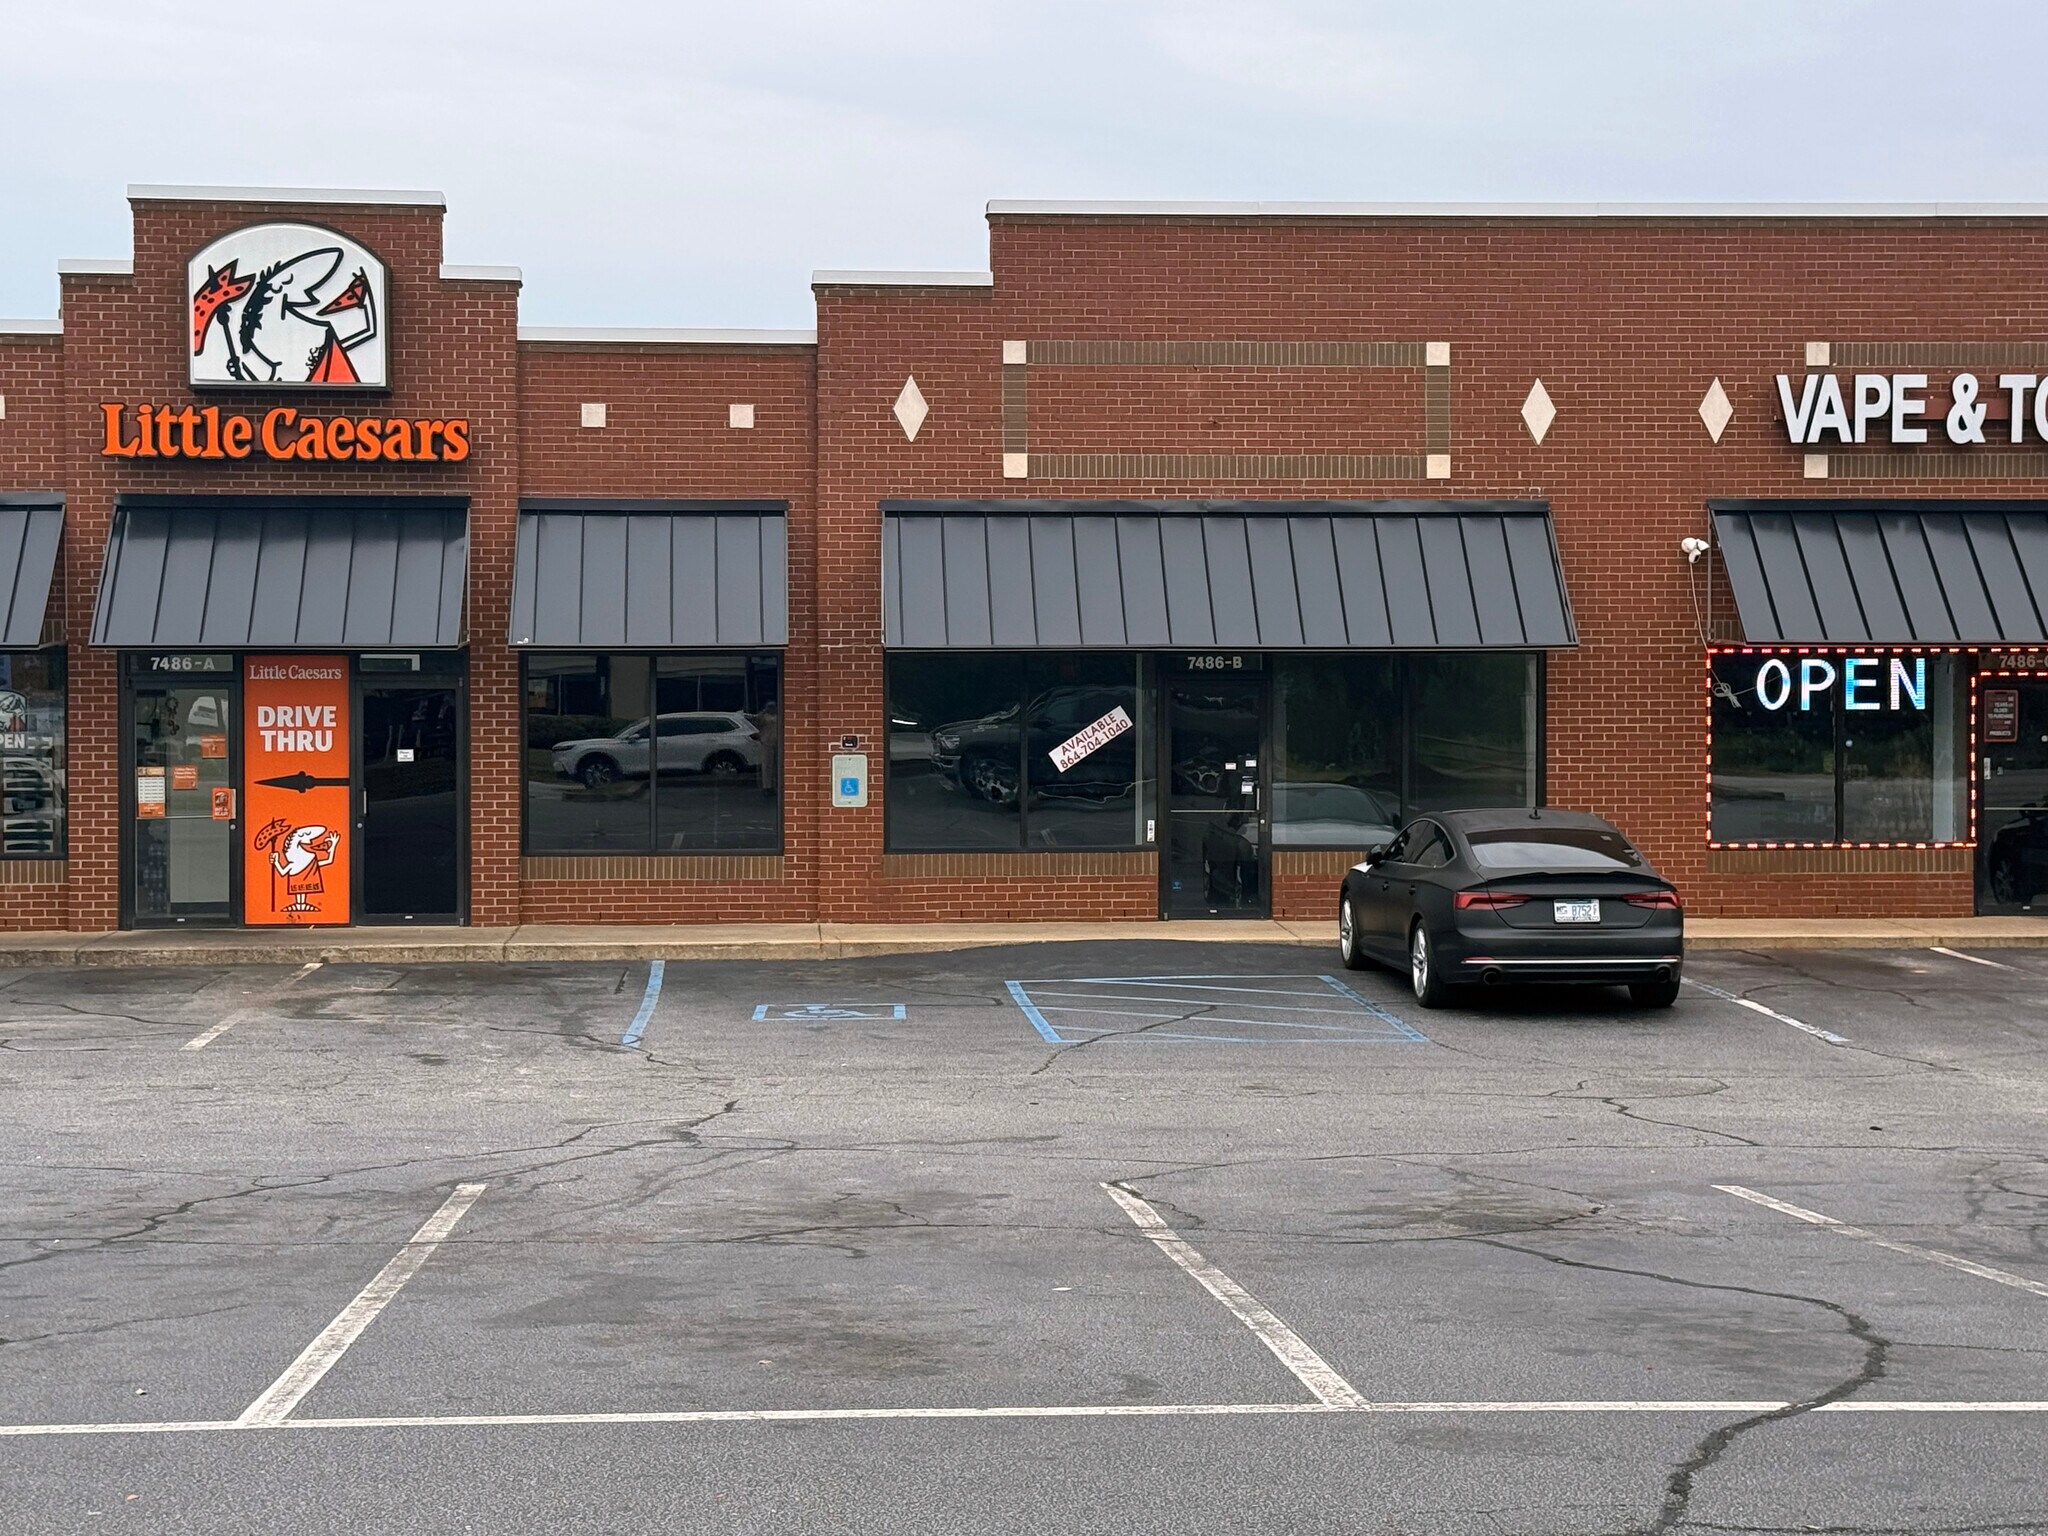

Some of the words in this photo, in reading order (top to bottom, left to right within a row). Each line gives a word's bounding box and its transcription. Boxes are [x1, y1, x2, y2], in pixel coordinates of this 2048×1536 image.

[1775, 374, 1928, 443] VAPE
[1946, 373, 1988, 444] &
[100, 402, 253, 460] Little
[261, 407, 471, 462] Caesars
[150, 656, 215, 670] 7486-A
[250, 665, 287, 680] Little
[288, 665, 342, 680] Caesars
[1187, 656, 1243, 670] 7486-B
[1999, 655, 2048, 669] 7486-
[1756, 657, 1926, 711] OPEN
[257, 705, 337, 728] DRIVE
[260, 730, 333, 752] THRU
[1060, 719, 1128, 769] 864-704-1040
[1061, 713, 1117, 756] AVAILABLE
